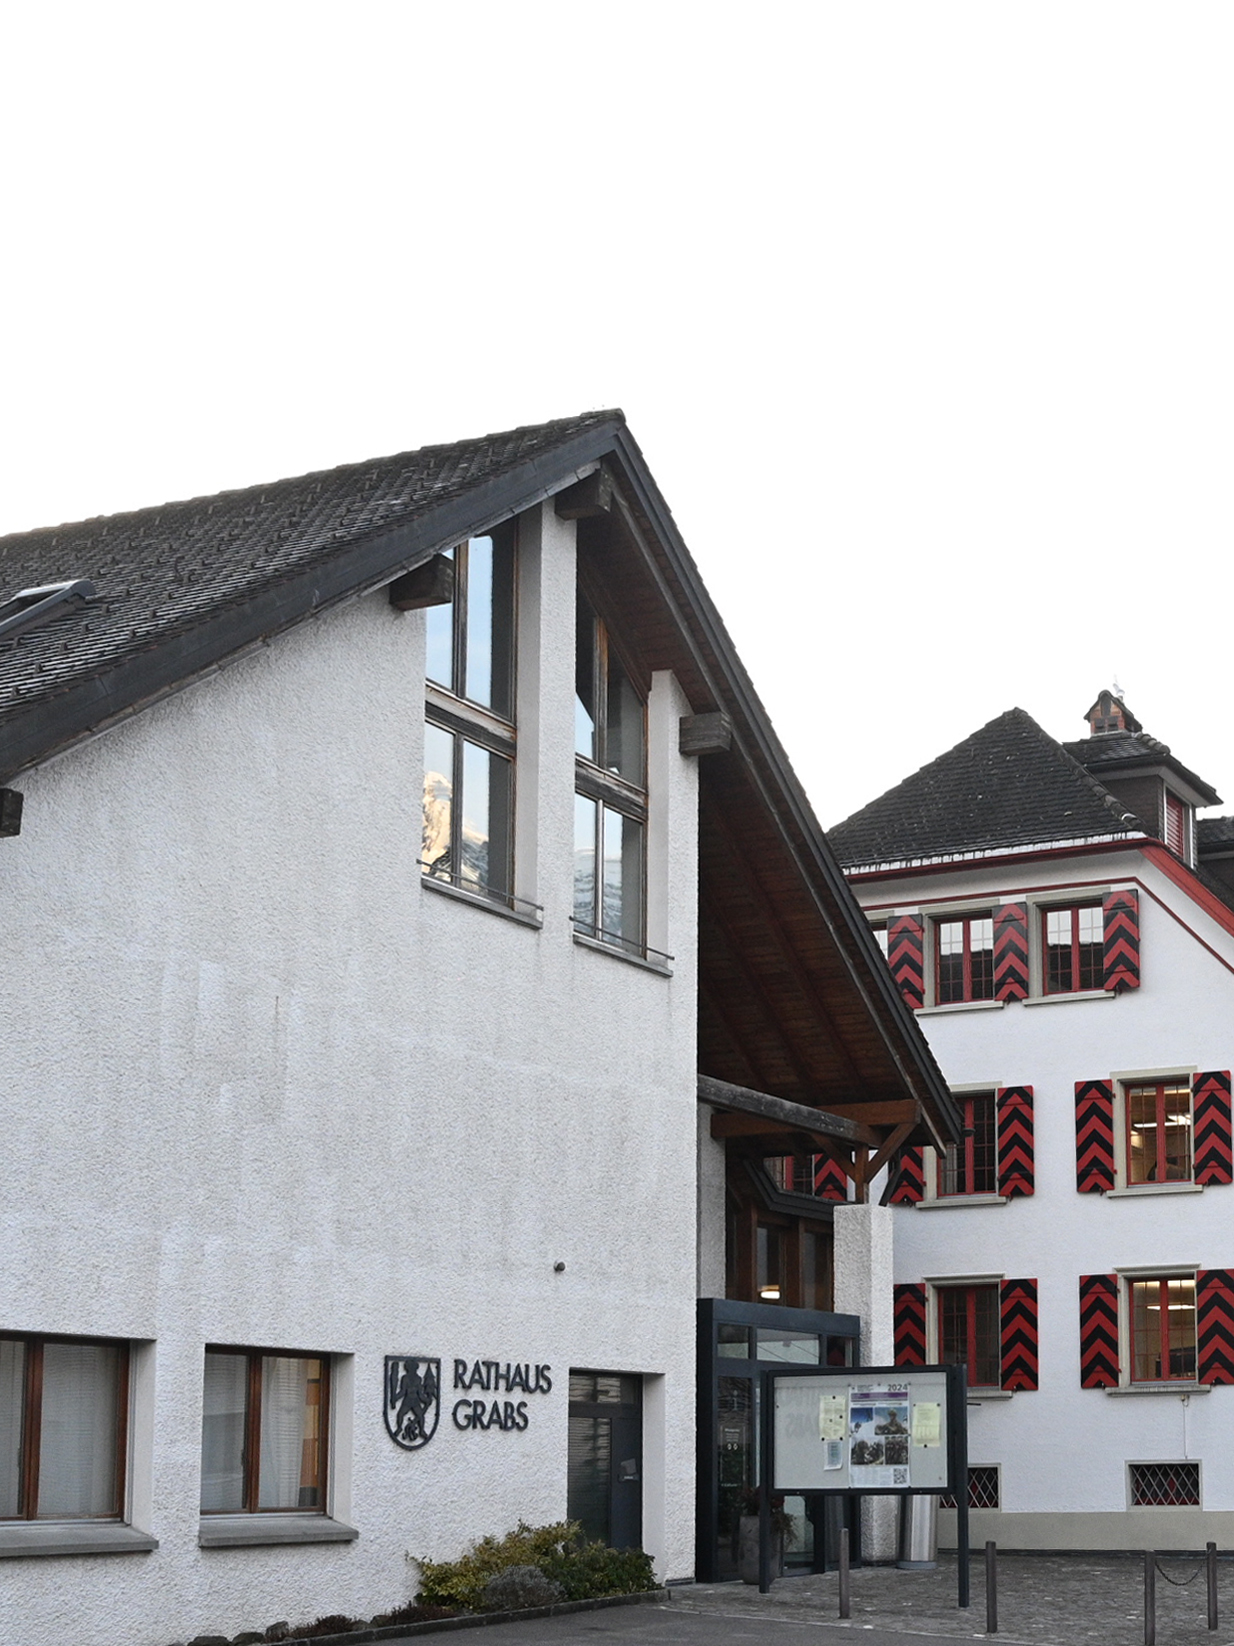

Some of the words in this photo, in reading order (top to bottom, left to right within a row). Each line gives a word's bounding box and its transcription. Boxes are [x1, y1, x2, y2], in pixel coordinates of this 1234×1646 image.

[453, 1358, 552, 1394] RATHAUS
[888, 1383, 908, 1392] 2024
[452, 1399, 529, 1432] GRABS
